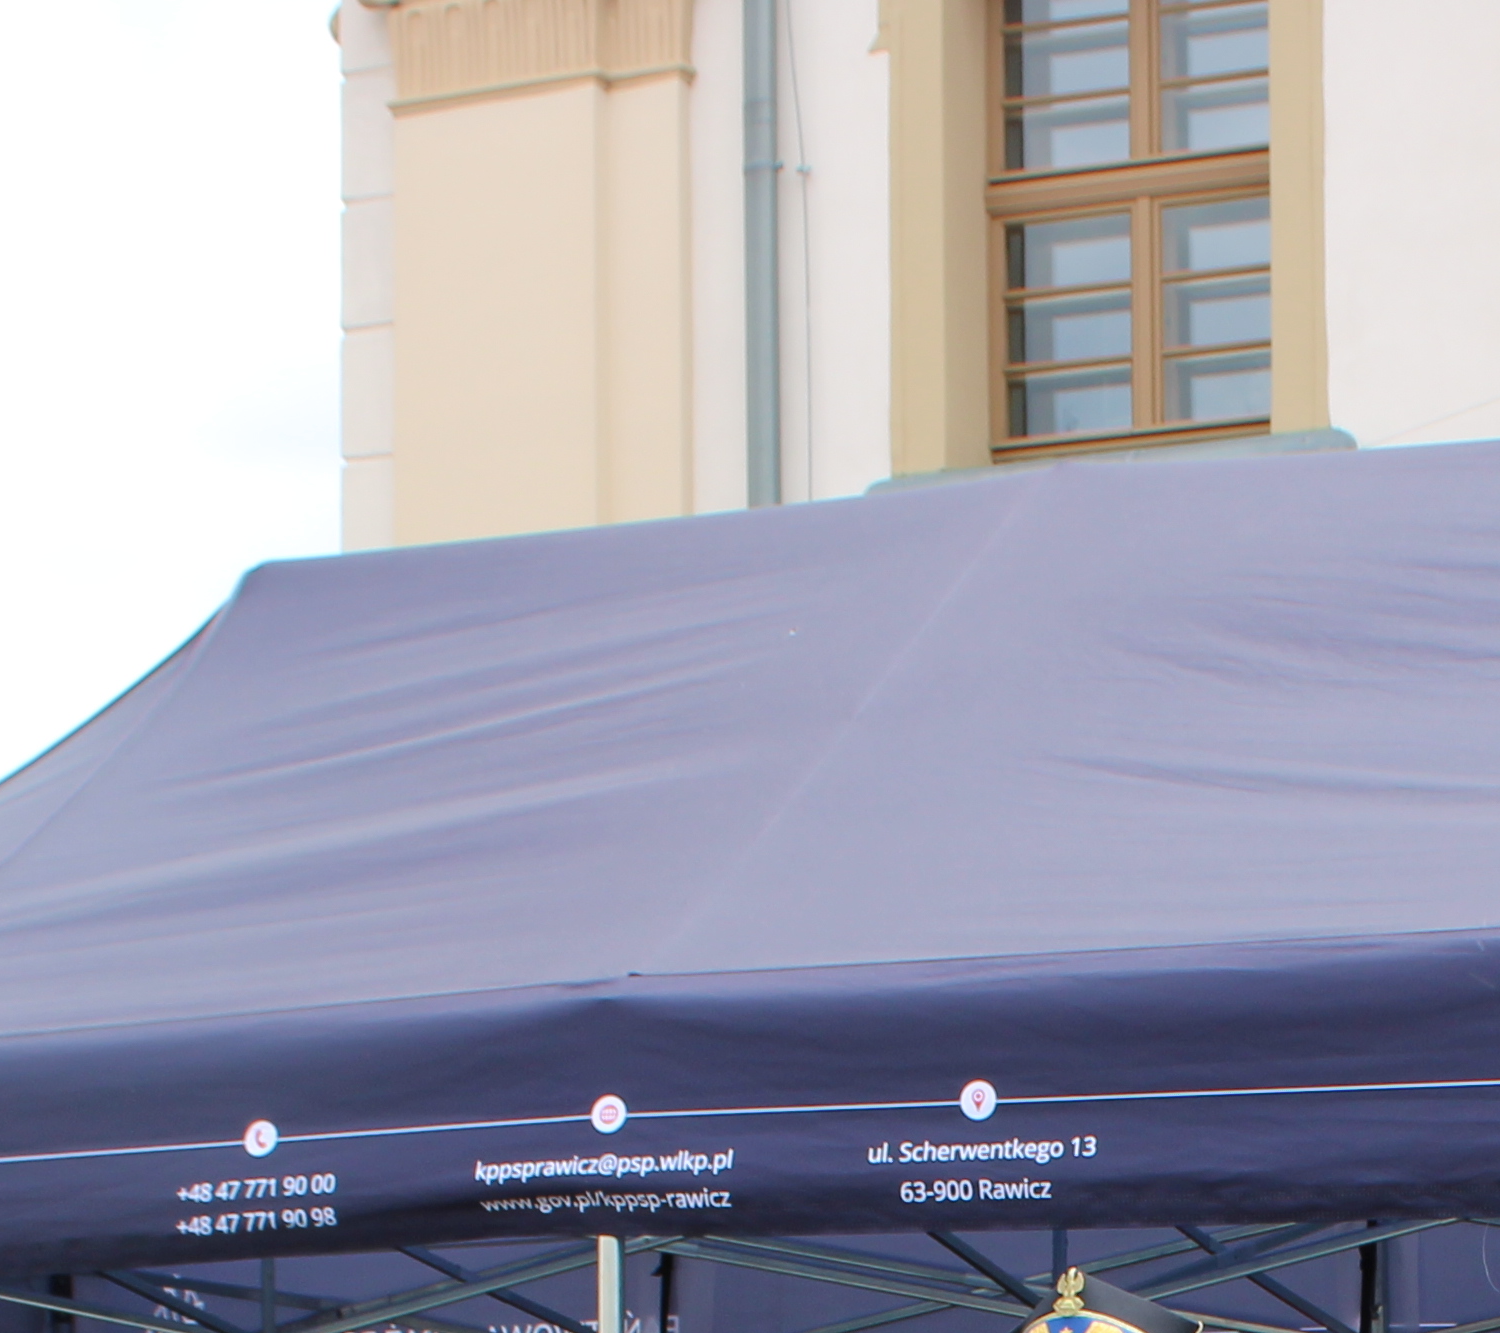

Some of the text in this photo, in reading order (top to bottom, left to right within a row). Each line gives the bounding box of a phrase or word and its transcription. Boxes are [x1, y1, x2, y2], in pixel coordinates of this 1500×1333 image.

[867, 1135, 1098, 1165] ul. Scherwentkego 13
[474, 1148, 735, 1186] kppsprawicz@psp.wlkp.pl
[176, 1173, 336, 1204] +48 47 771 90 00
[479, 1186, 732, 1214] www.gov.pl/kppsp-rawicz
[900, 1177, 1052, 1203] 63-900 Rawicz
[176, 1206, 337, 1237] +48 47 771 90 98
